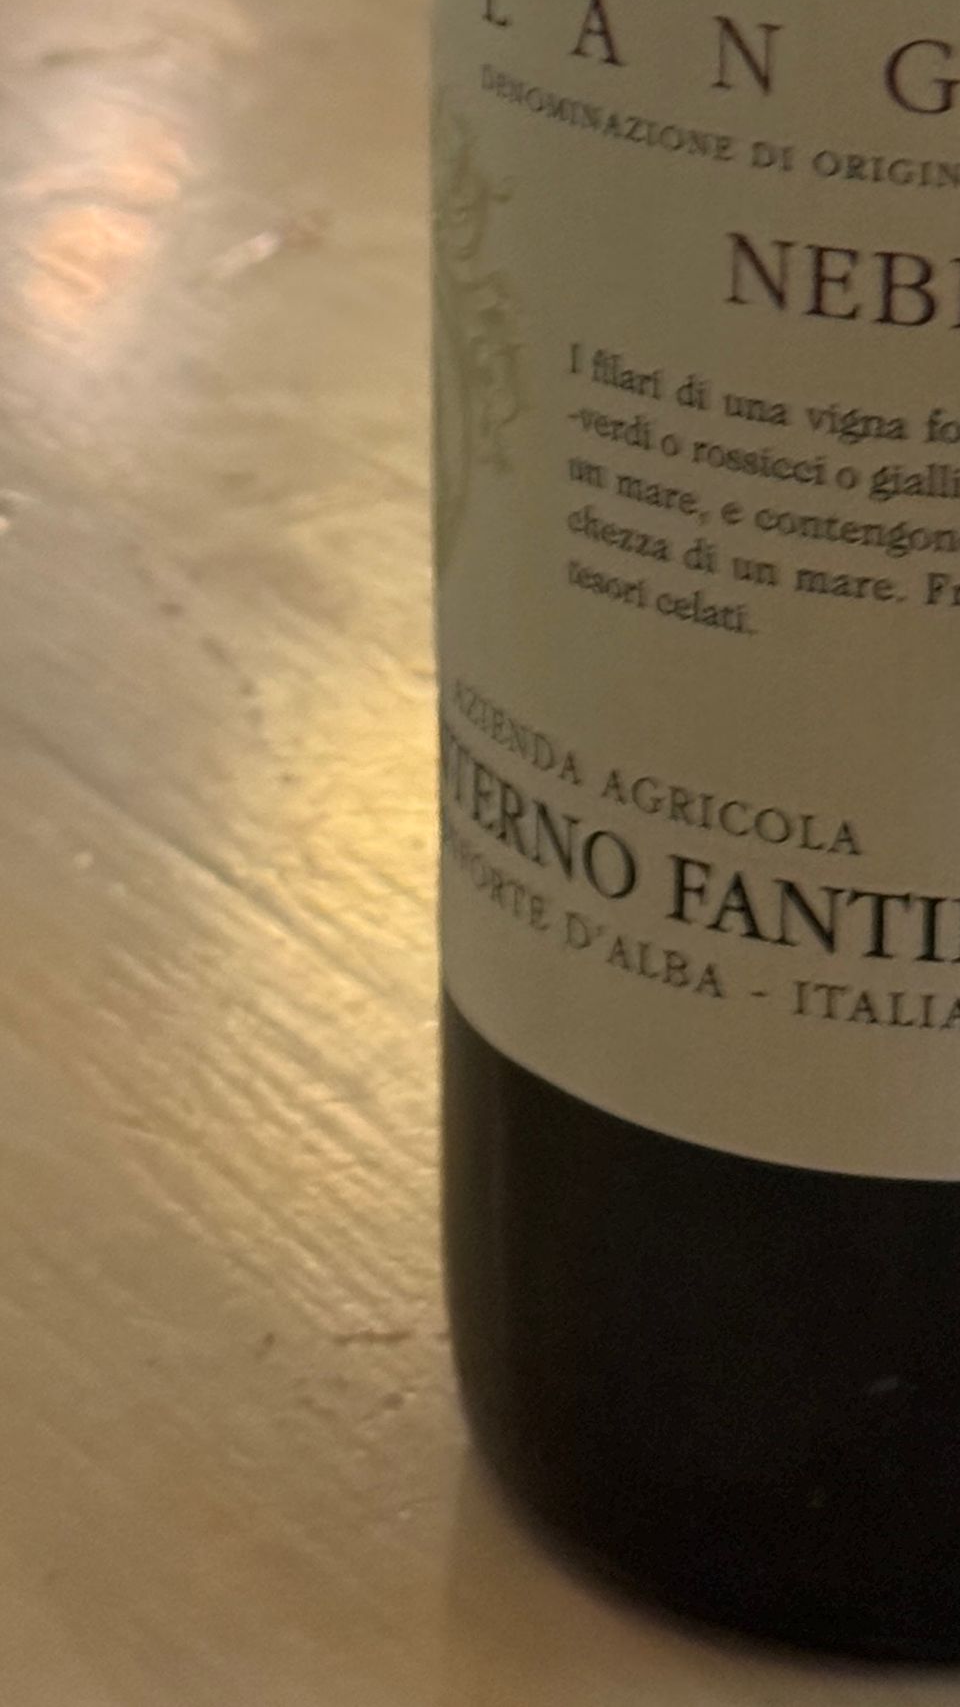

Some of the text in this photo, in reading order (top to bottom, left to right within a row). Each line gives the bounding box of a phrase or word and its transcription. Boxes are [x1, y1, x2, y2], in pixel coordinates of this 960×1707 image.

[480, 63, 734, 162] DENOMINAZIONE
[751, 140, 795, 172] DI
[569, 343, 582, 375] I
[592, 348, 662, 400] filari
[675, 373, 709, 412] di
[724, 394, 788, 427] una
[806, 404, 909, 445] vigna
[567, 408, 654, 452] -verdi
[660, 433, 680, 458] o
[693, 440, 826, 488] rossicci
[836, 465, 857, 491] o
[567, 456, 603, 488] un
[616, 472, 710, 524] mare,
[719, 500, 744, 527] e
[567, 505, 669, 563] chezza
[684, 539, 718, 574] di
[731, 554, 779, 587] un
[795, 563, 904, 603] mare.
[567, 557, 758, 636] tesori celati.
[444, 724, 638, 900] TERNO
[453, 678, 864, 856] AZIENDA AGRICOLA
[563, 910, 726, 998] D'ALBA
